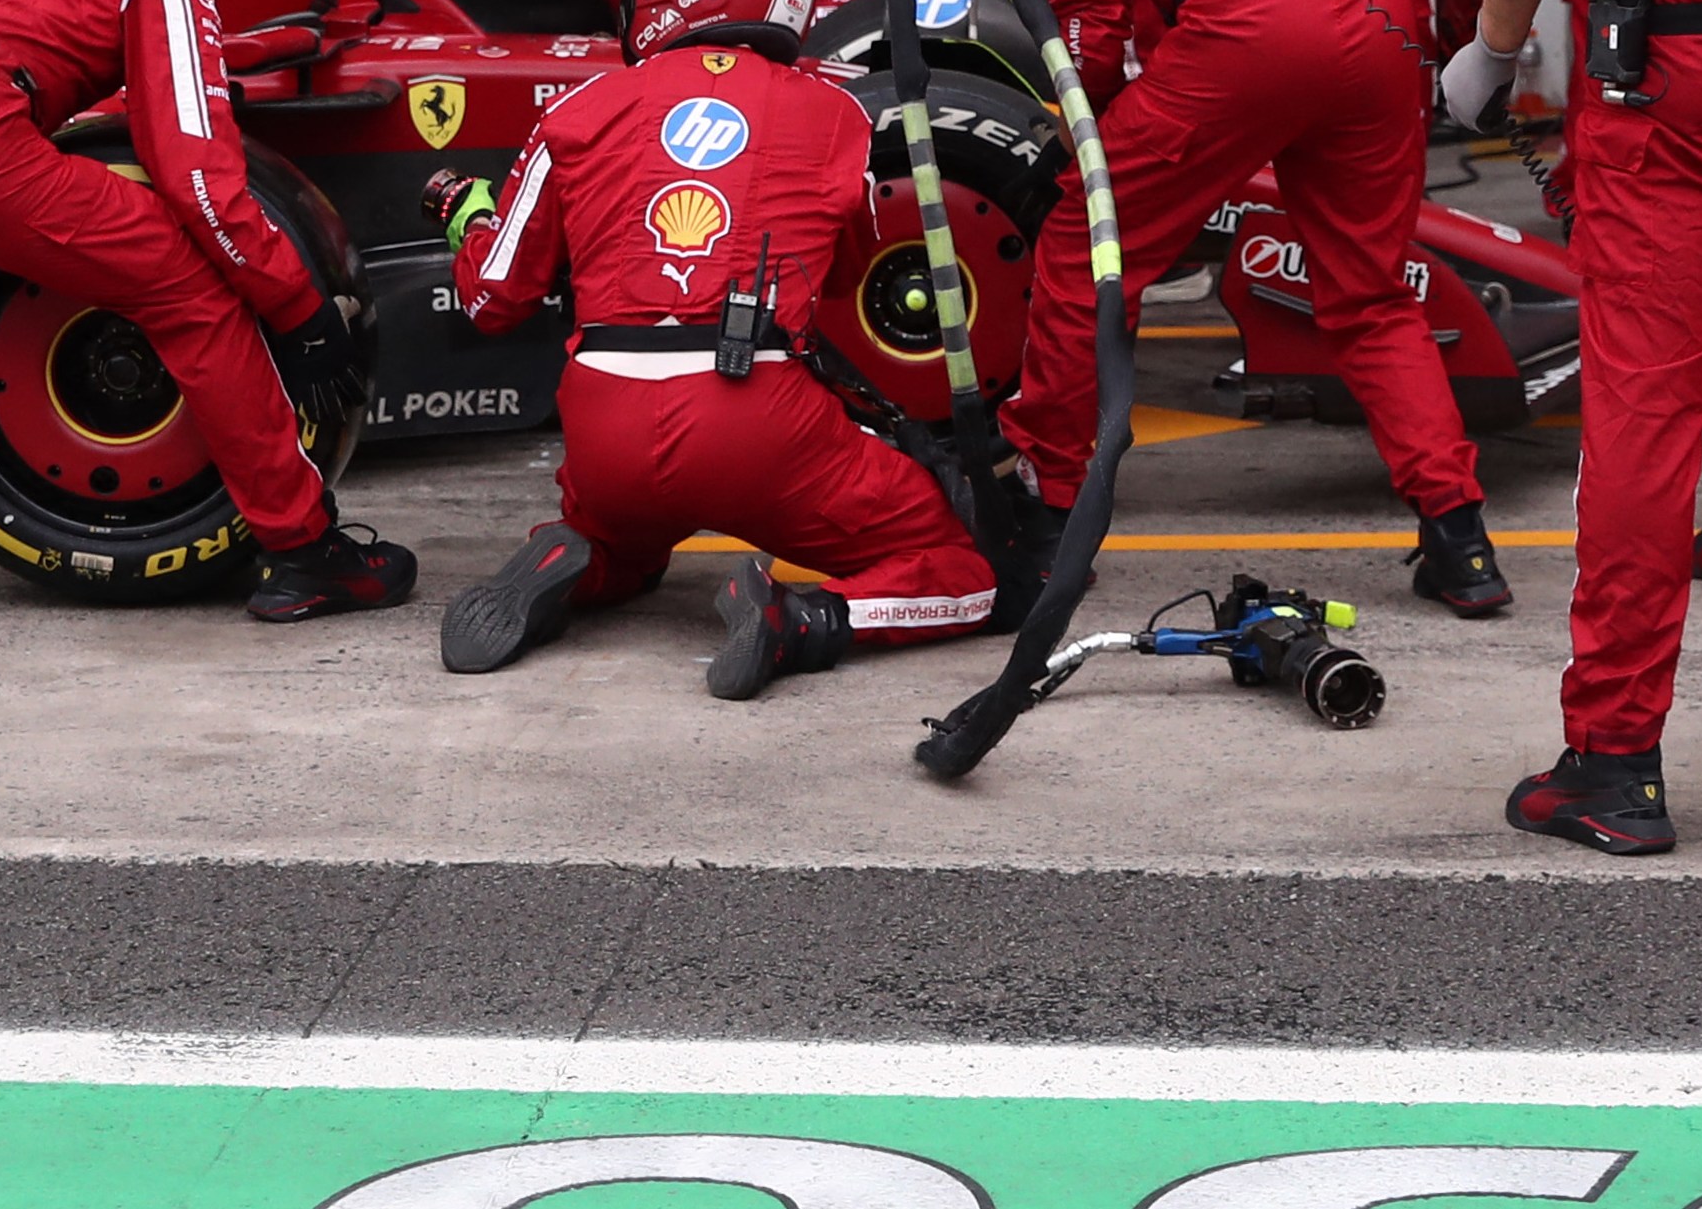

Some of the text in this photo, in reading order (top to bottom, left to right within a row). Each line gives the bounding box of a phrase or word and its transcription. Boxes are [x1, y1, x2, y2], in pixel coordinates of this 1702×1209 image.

[667, 97, 745, 169] hp
[929, 105, 1042, 167] ZER
[190, 168, 247, 268] RICHARD MILLE
[402, 389, 522, 421] POKER
